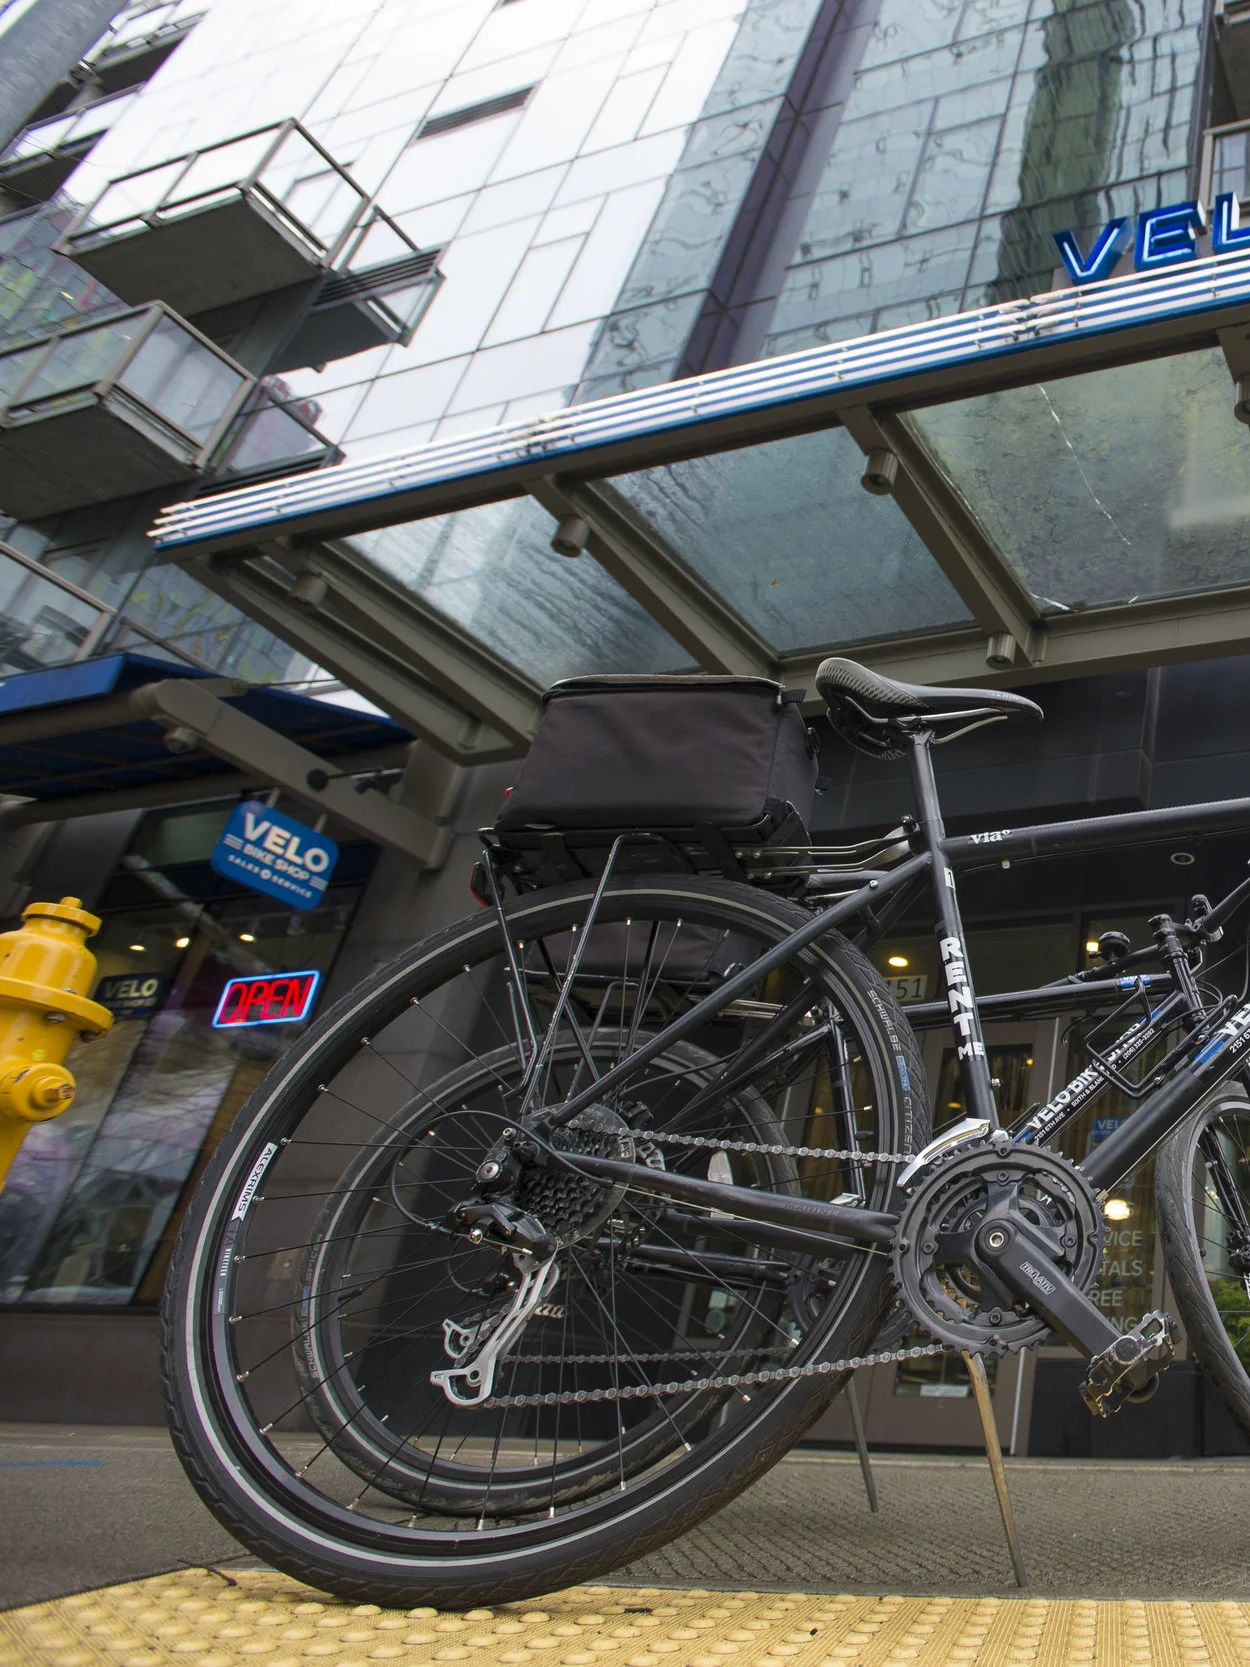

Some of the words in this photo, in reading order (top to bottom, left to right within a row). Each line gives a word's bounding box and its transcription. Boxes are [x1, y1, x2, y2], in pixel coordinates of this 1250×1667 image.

[242, 843, 275, 866] BIKE
[273, 858, 310, 880] SHOP
[245, 812, 330, 873] VELO
[228, 854, 259, 874] SALES
[271, 875, 312, 899] SERVICE
[104, 978, 159, 999] VELO
[220, 976, 314, 1024] OPEN
[940, 937, 975, 1037] RENT
[867, 989, 902, 1051] SCHWALBE
[957, 1042, 985, 1061] ME
[1229, 1035, 1248, 1053] 2151
[1045, 1119, 1057, 1132] 6TH
[1054, 1112, 1066, 1124] AVE
[1071, 1094, 1087, 1108] SIXTH
[1122, 1044, 1136, 1060] (206)
[1133, 1028, 1155, 1049] 325-3292
[1026, 1090, 1071, 1130] VELO
[238, 1146, 273, 1212] ALEXRIMS
[1020, 1261, 1056, 1295] TRUVATIV
